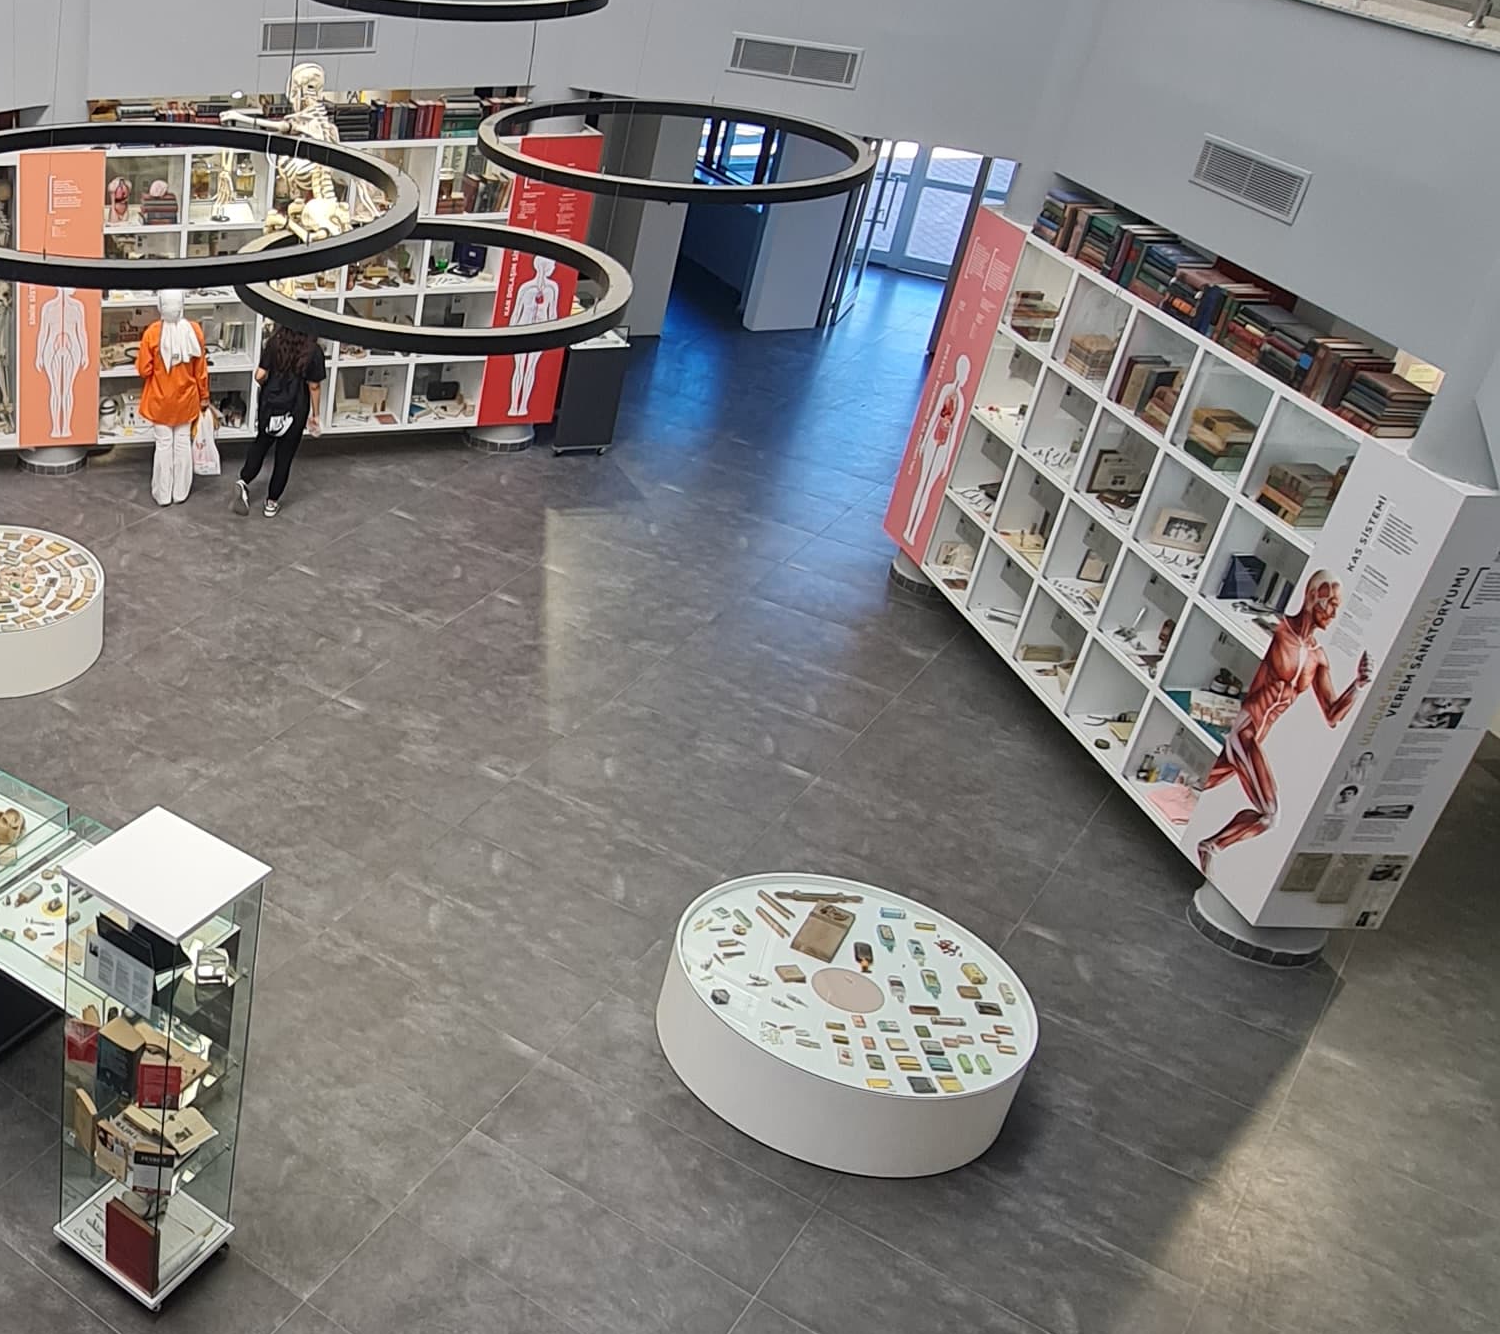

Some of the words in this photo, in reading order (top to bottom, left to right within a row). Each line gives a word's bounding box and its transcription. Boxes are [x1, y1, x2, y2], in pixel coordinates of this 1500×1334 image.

[1346, 547, 1362, 572] KAS
[1359, 494, 1387, 545] SİSTEMİ
[1385, 673, 1416, 718] VEREM
[1410, 567, 1470, 670] SANATORYUMU
